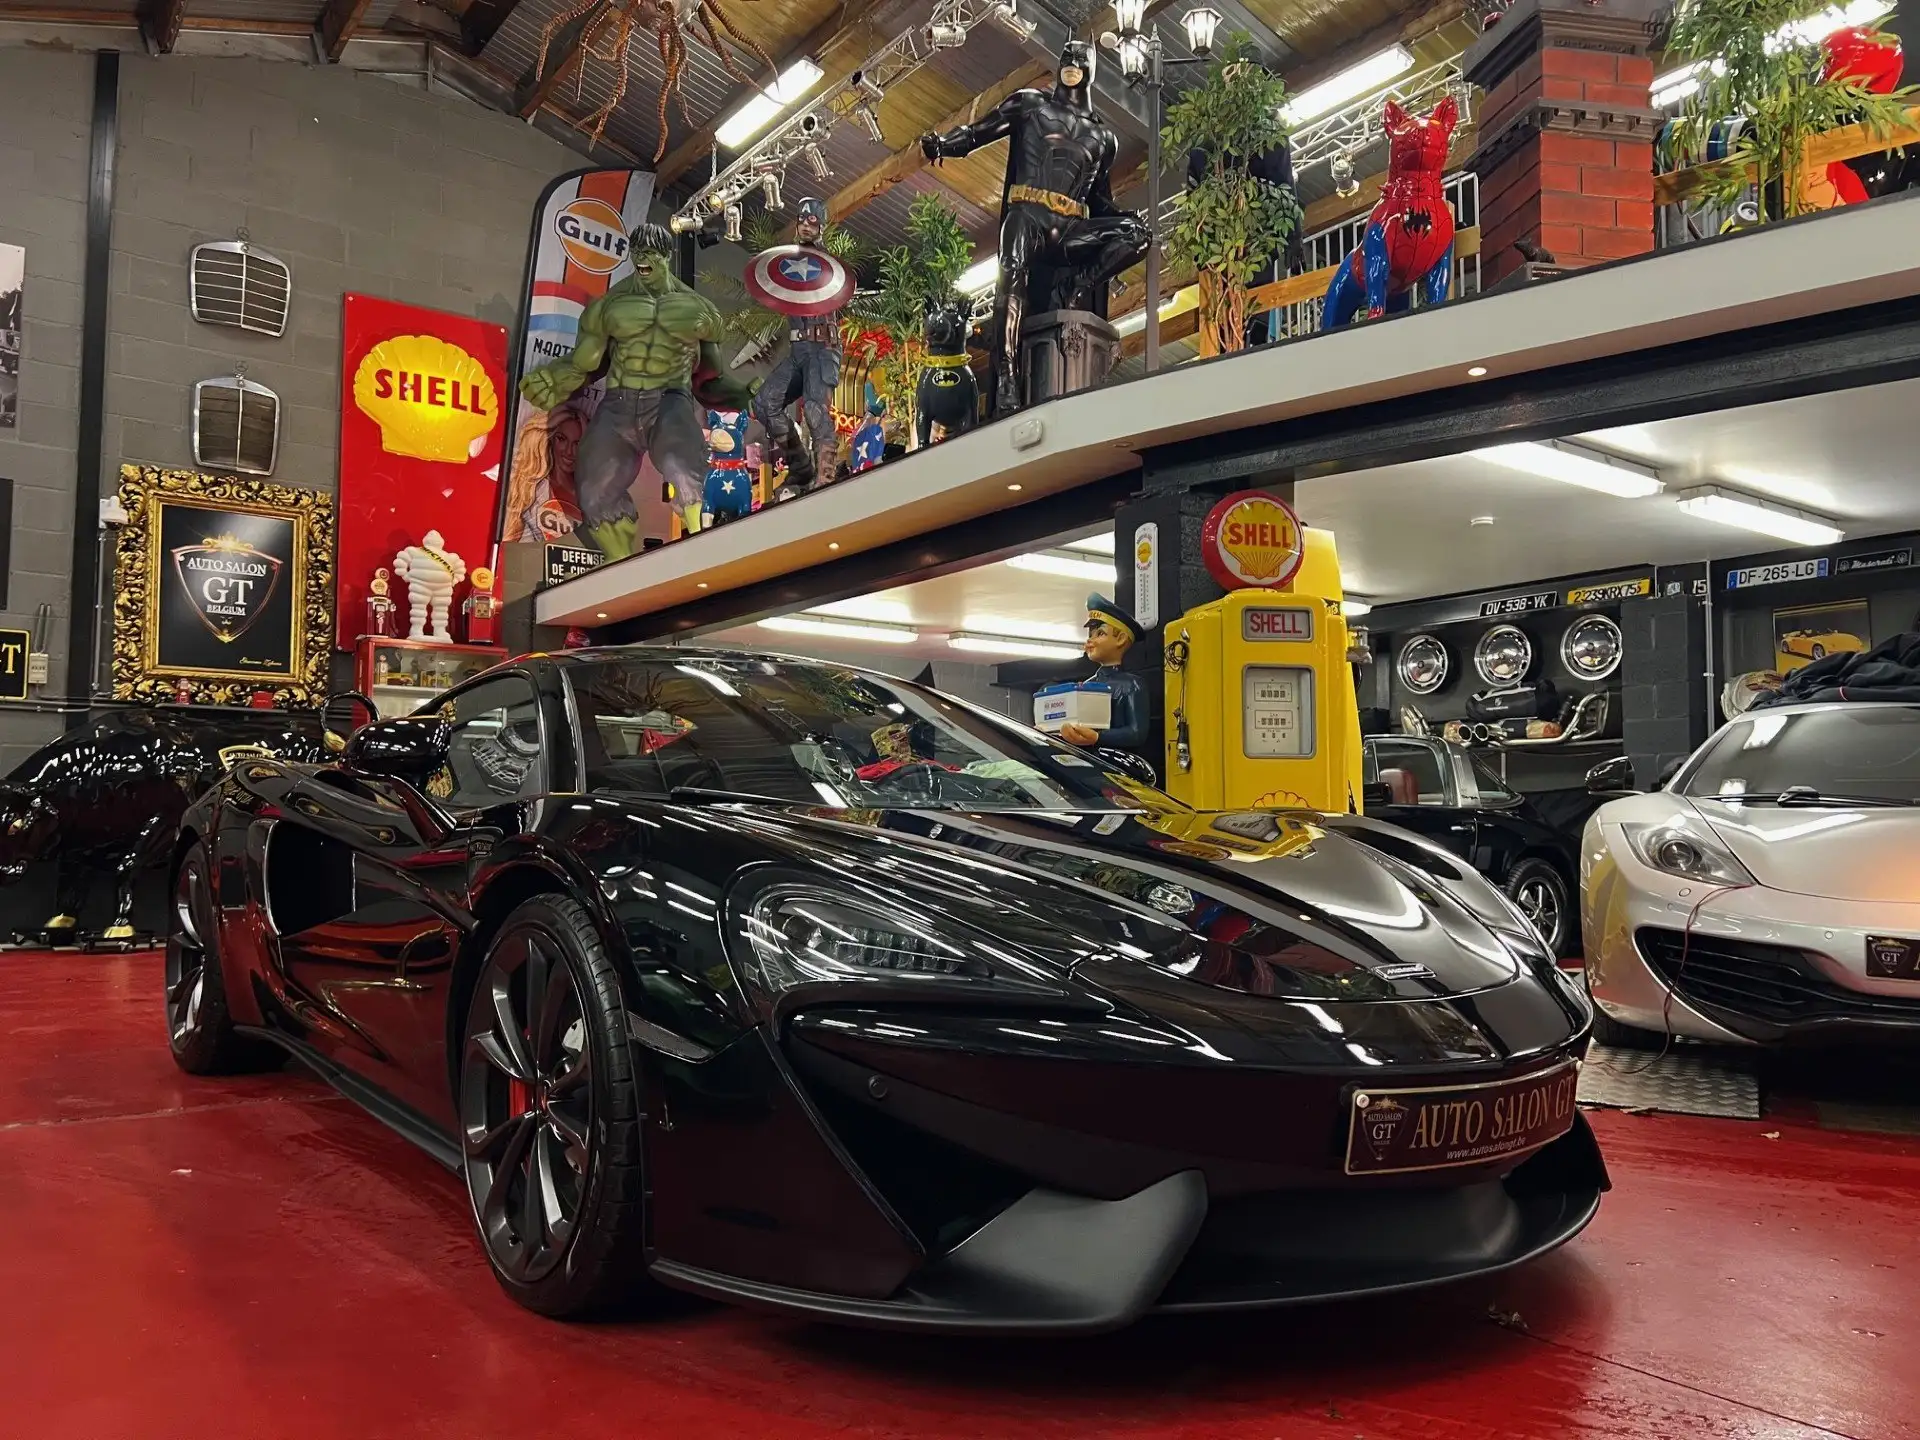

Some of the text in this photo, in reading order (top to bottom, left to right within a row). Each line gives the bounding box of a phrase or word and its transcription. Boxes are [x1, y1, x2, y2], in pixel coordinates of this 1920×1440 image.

[801, 202, 811, 213] A
[558, 215, 628, 257] Gulf
[533, 337, 576, 358] MART
[374, 368, 487, 416] SHELL
[1227, 522, 1292, 548] SHELL
[186, 557, 268, 575] AUTO SALON
[562, 549, 605, 566] DEFENSE
[551, 563, 565, 576] DE
[1738, 562, 1815, 585] DF-265-LG
[202, 576, 254, 606] GT
[206, 604, 247, 616] BELGIUM
[1249, 612, 1303, 634] SHELL
[1881, 951, 1901, 963] GT
[1408, 1073, 1576, 1149] AUTO SALON GT
[1372, 1123, 1396, 1140] GT
[1446, 1136, 1527, 1160] www.autosalongt.be
